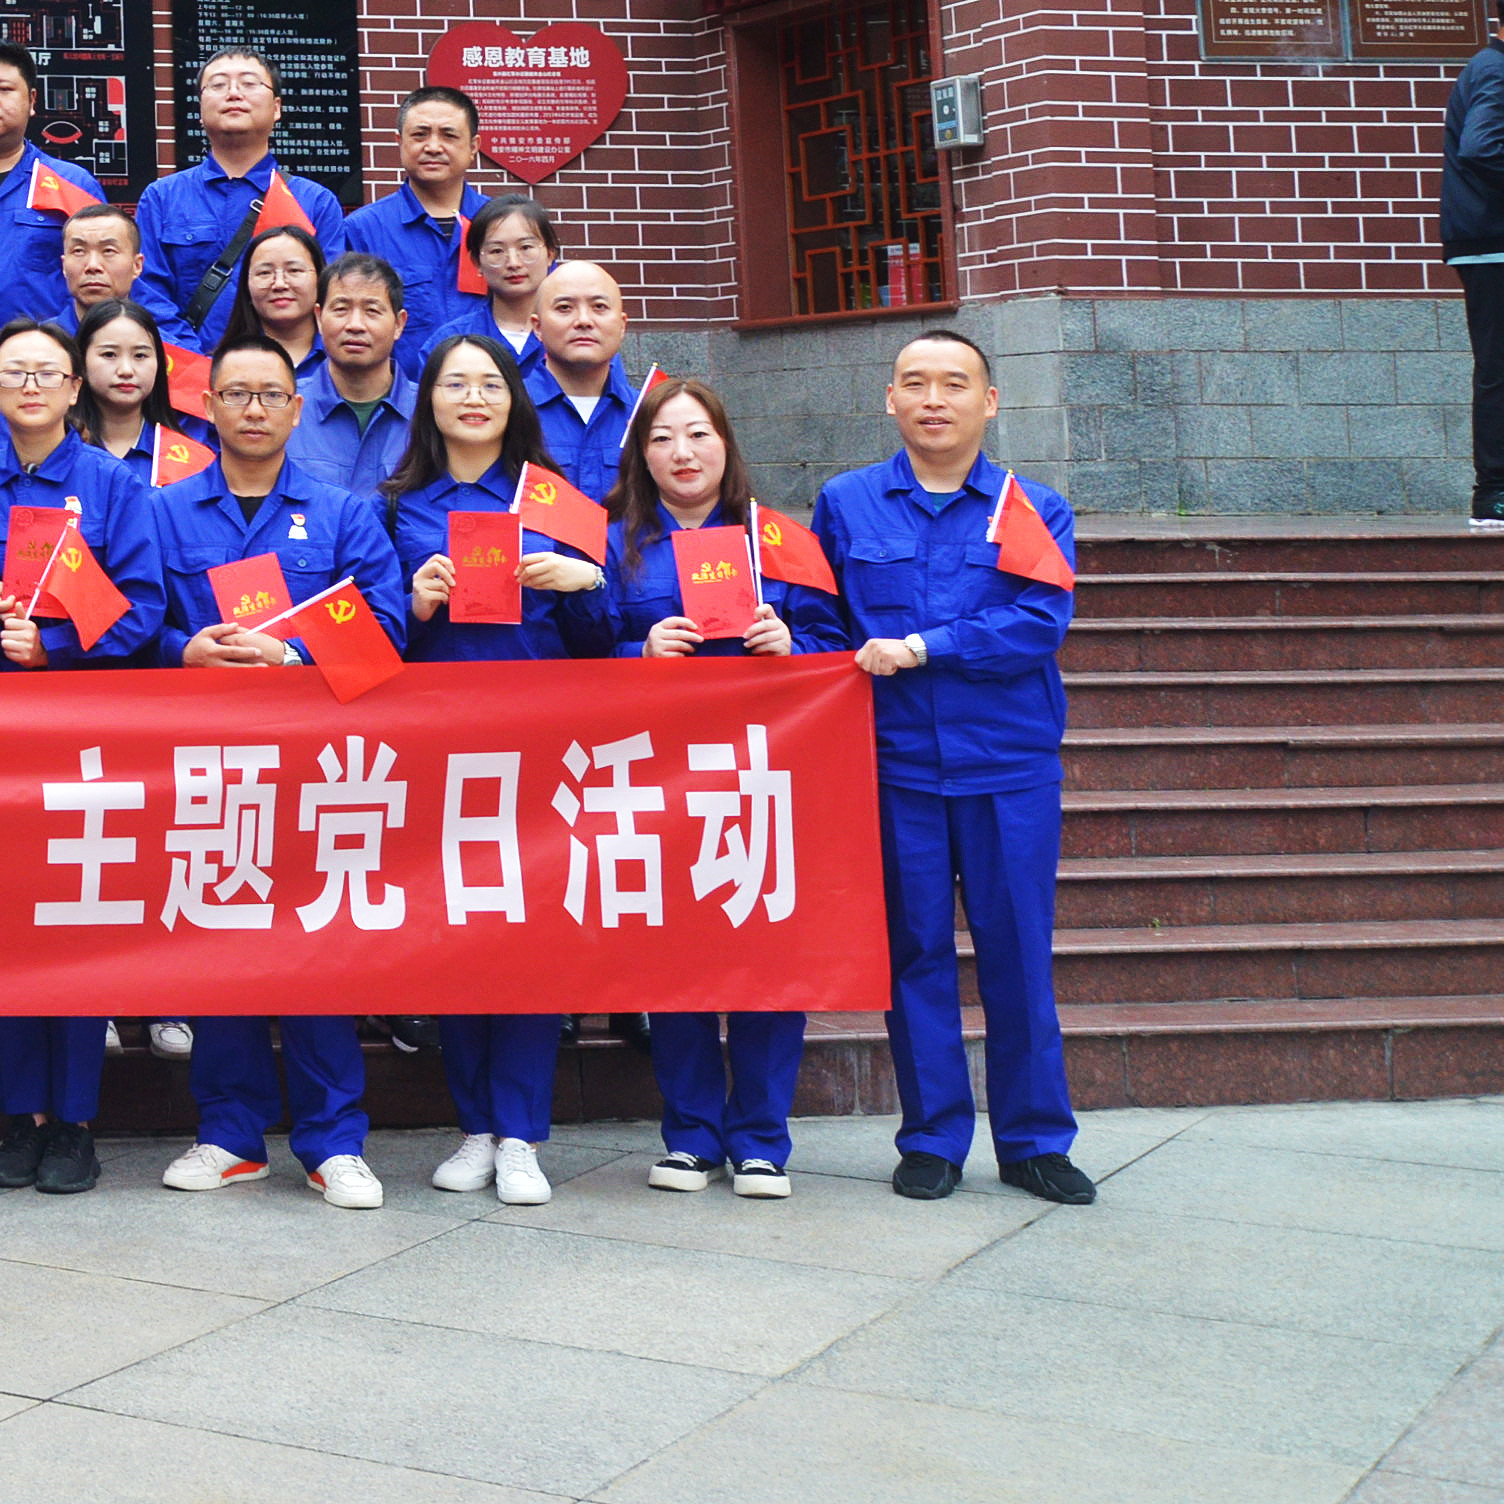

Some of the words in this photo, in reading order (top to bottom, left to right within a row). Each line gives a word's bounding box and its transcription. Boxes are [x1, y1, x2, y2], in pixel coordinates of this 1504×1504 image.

[462, 46, 591, 68] 感恩教育基地
[34, 724, 796, 933] 主题党日活动
